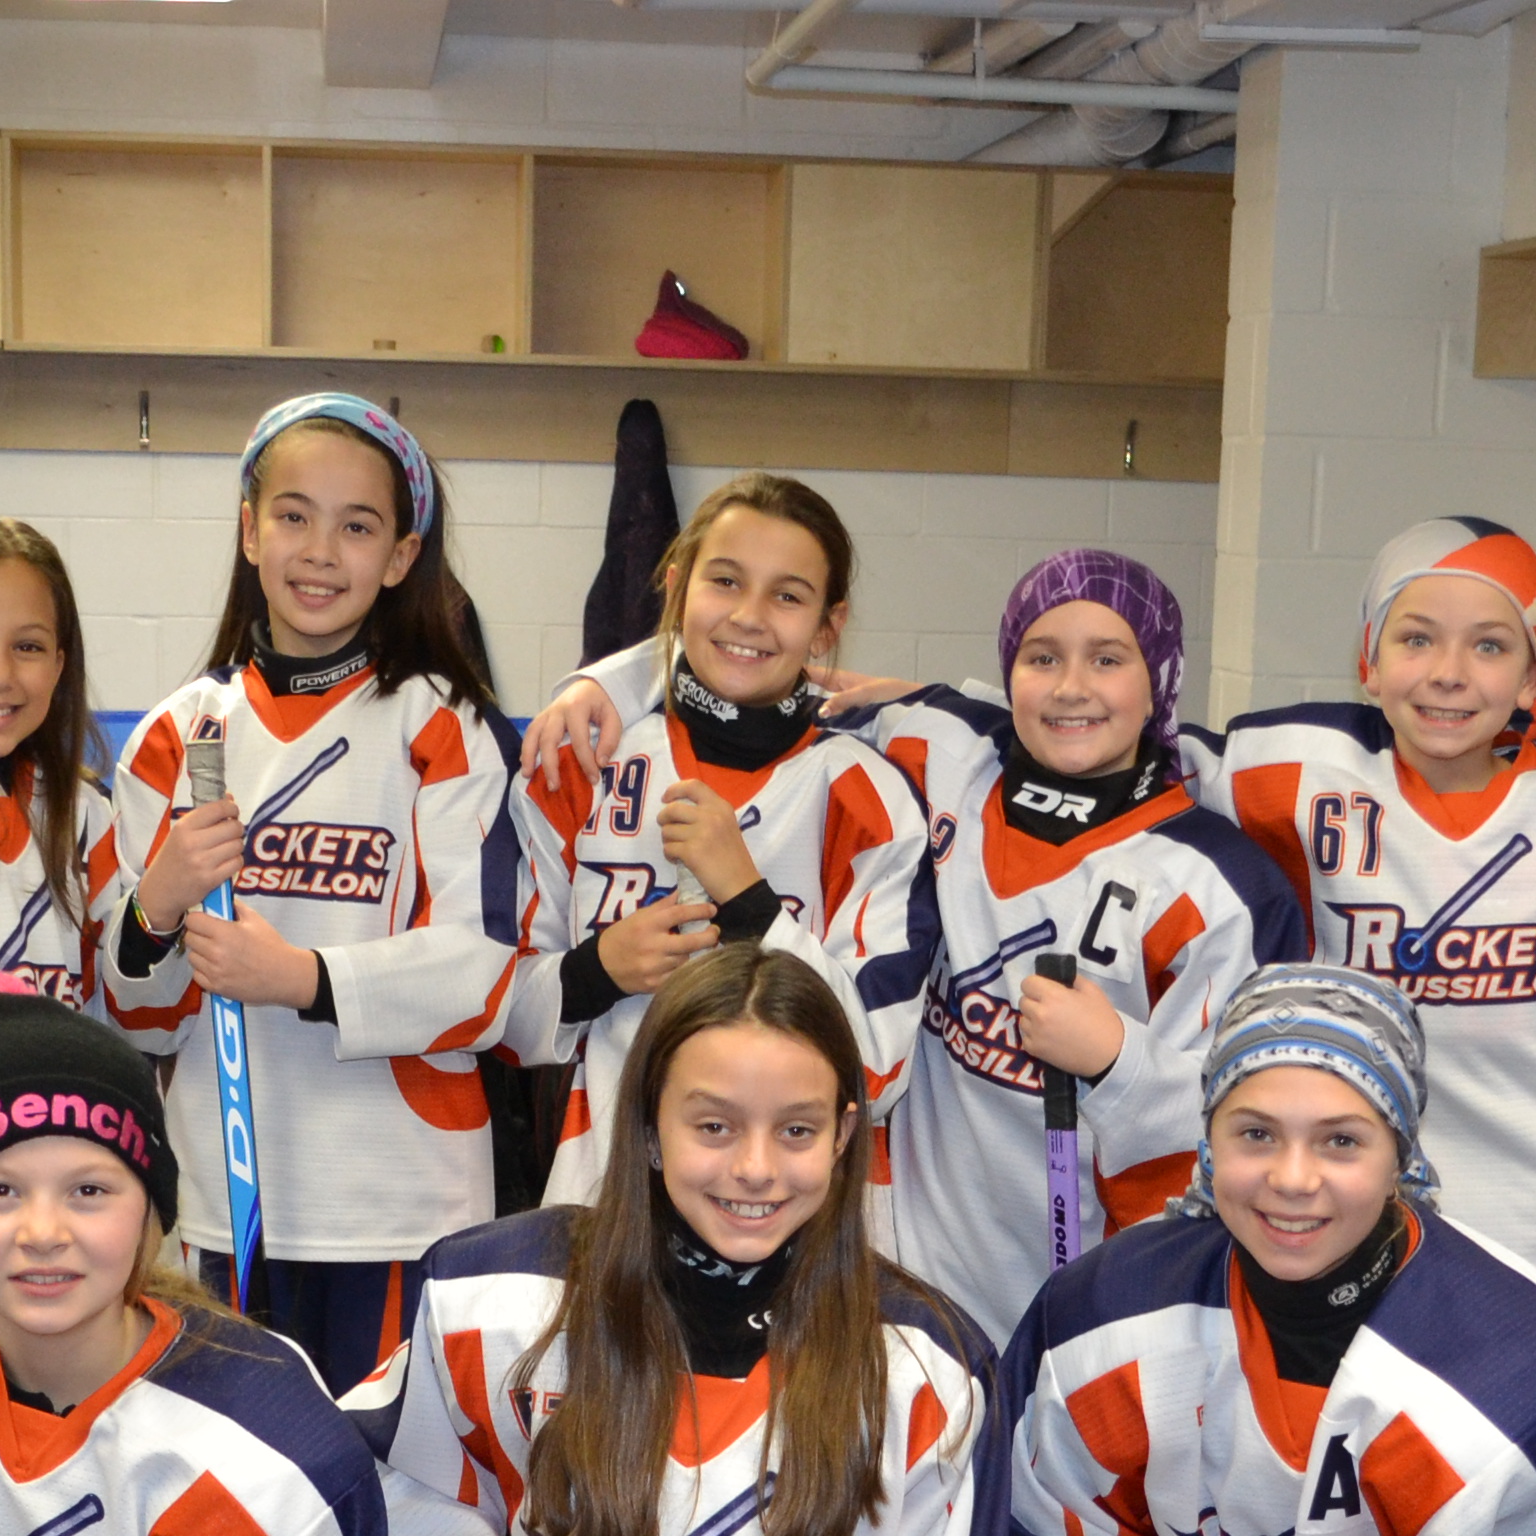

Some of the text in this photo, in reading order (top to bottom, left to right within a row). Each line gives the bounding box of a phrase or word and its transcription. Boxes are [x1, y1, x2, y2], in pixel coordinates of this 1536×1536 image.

[1012, 782, 1098, 824] DR
[1309, 787, 1385, 877] 67
[1078, 880, 1138, 967] C
[1307, 1433, 1361, 1521] A
